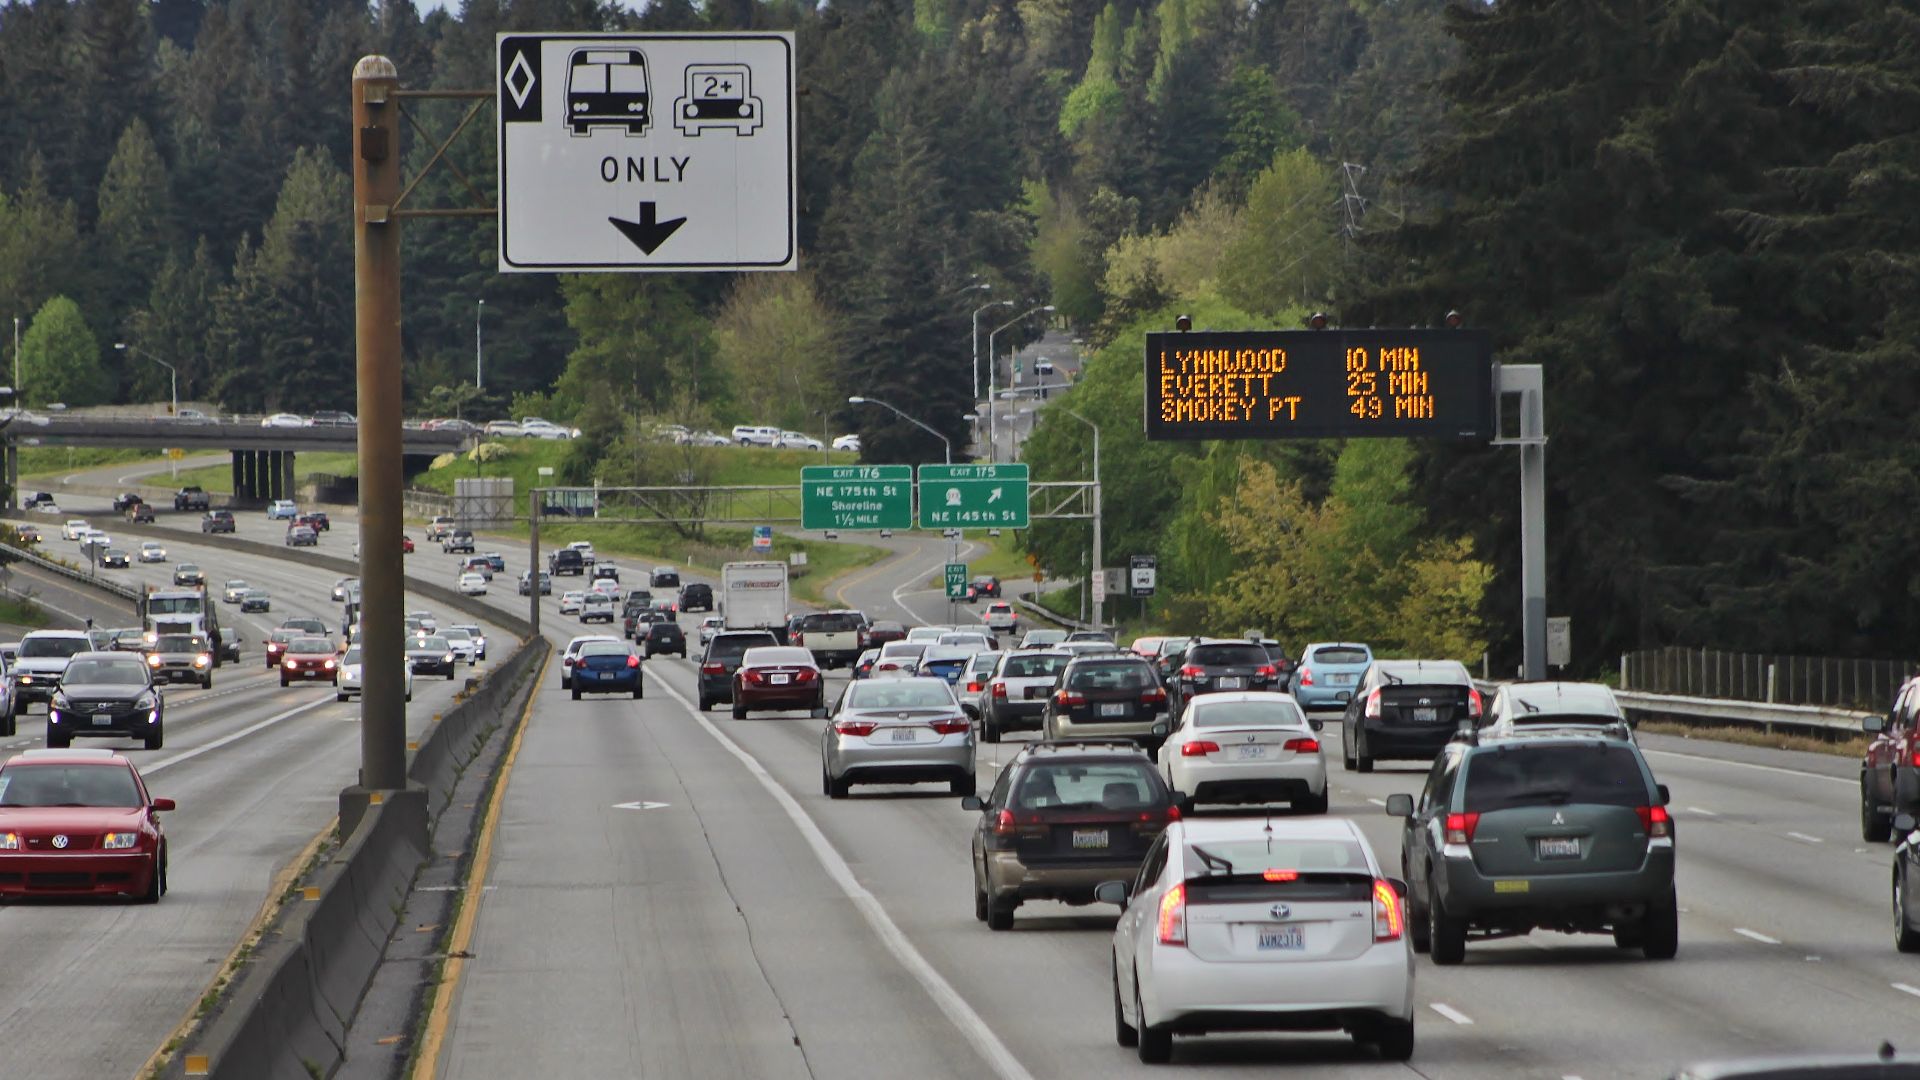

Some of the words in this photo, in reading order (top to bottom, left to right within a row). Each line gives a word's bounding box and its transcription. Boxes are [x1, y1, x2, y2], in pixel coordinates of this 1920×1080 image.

[704, 77, 732, 97] 2+
[601, 157, 690, 183] ONLY
[1161, 350, 1286, 374] LYNNWOOD
[1347, 348, 1368, 371] 10
[1380, 348, 1419, 371] MIN
[1162, 374, 1273, 398] EVERETT
[1348, 372, 1376, 395] 25
[1389, 371, 1428, 395] MIN
[1162, 398, 1256, 421] SMOKEY
[1270, 397, 1301, 420] PT
[1351, 396, 1382, 418] 49
[1396, 395, 1433, 418] MIN
[833, 469, 854, 478] EXIT
[858, 467, 880, 478] 176
[950, 468, 970, 476] EXIT
[976, 466, 996, 477] 175
[816, 486, 833, 496] NE
[840, 486, 876, 496] 175th
[883, 486, 897, 496] St
[832, 501, 883, 511] Shoreline
[857, 515, 879, 523] MILE
[931, 512, 949, 521] NE
[956, 511, 995, 520] 145th
[1002, 511, 1016, 520] St
[948, 574, 963, 583] 175
